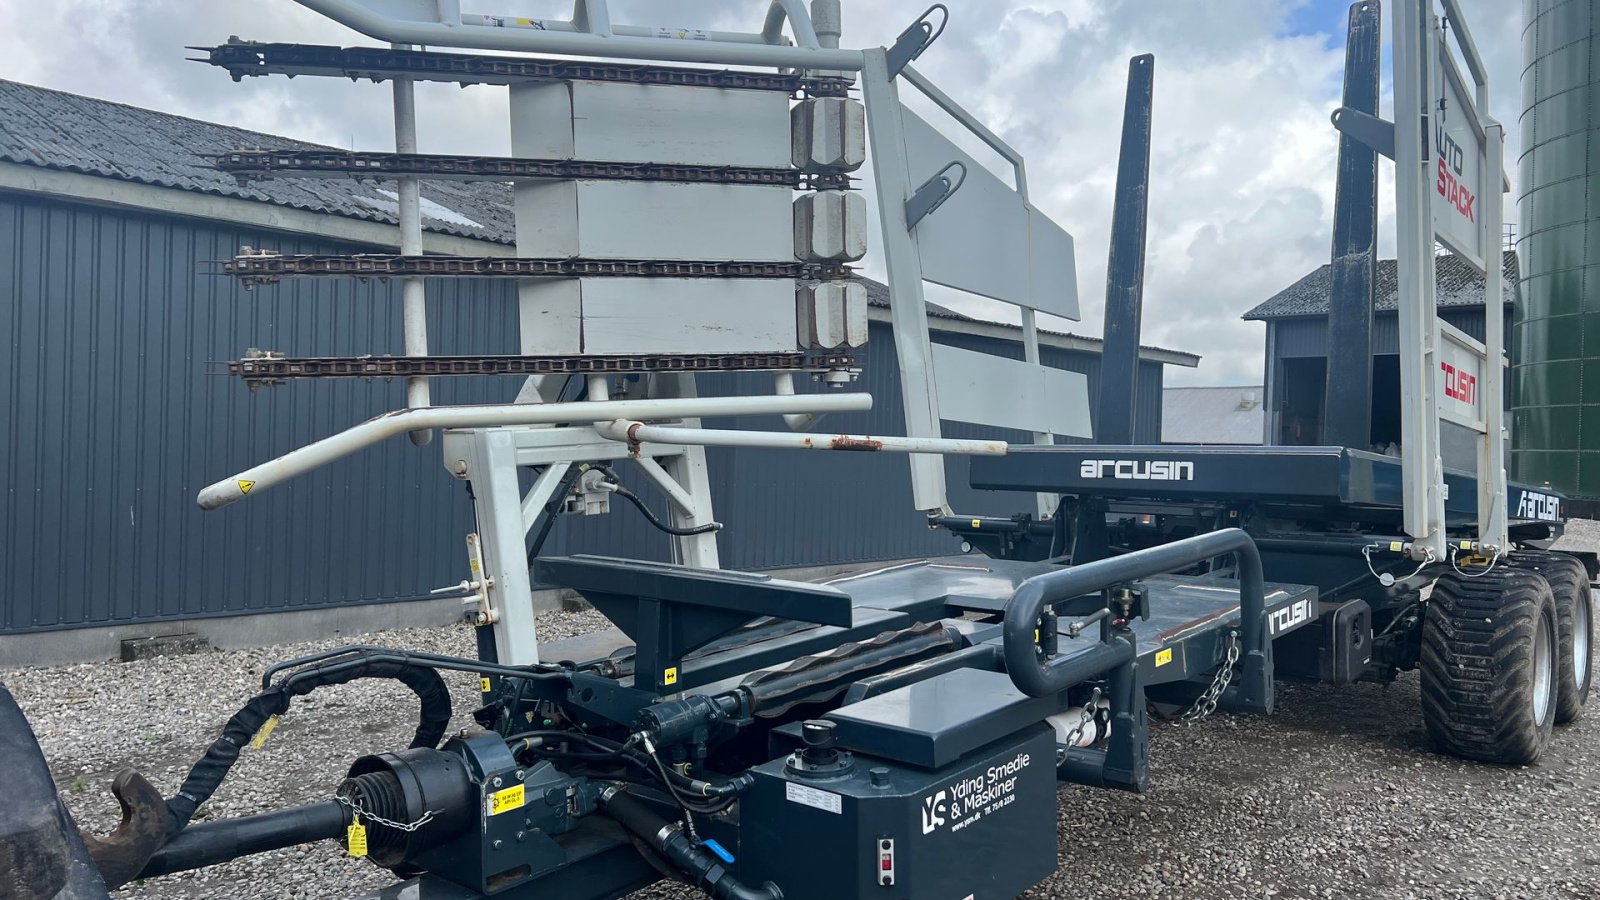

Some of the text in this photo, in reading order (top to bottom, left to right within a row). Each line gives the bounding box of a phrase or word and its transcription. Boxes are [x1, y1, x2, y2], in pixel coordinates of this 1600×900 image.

[1437, 157, 1476, 224] STACK
[1080, 459, 1194, 481] arcusin
[950, 752, 1030, 801] Yding Smedie
[950, 776, 1018, 820] & Maskiner
